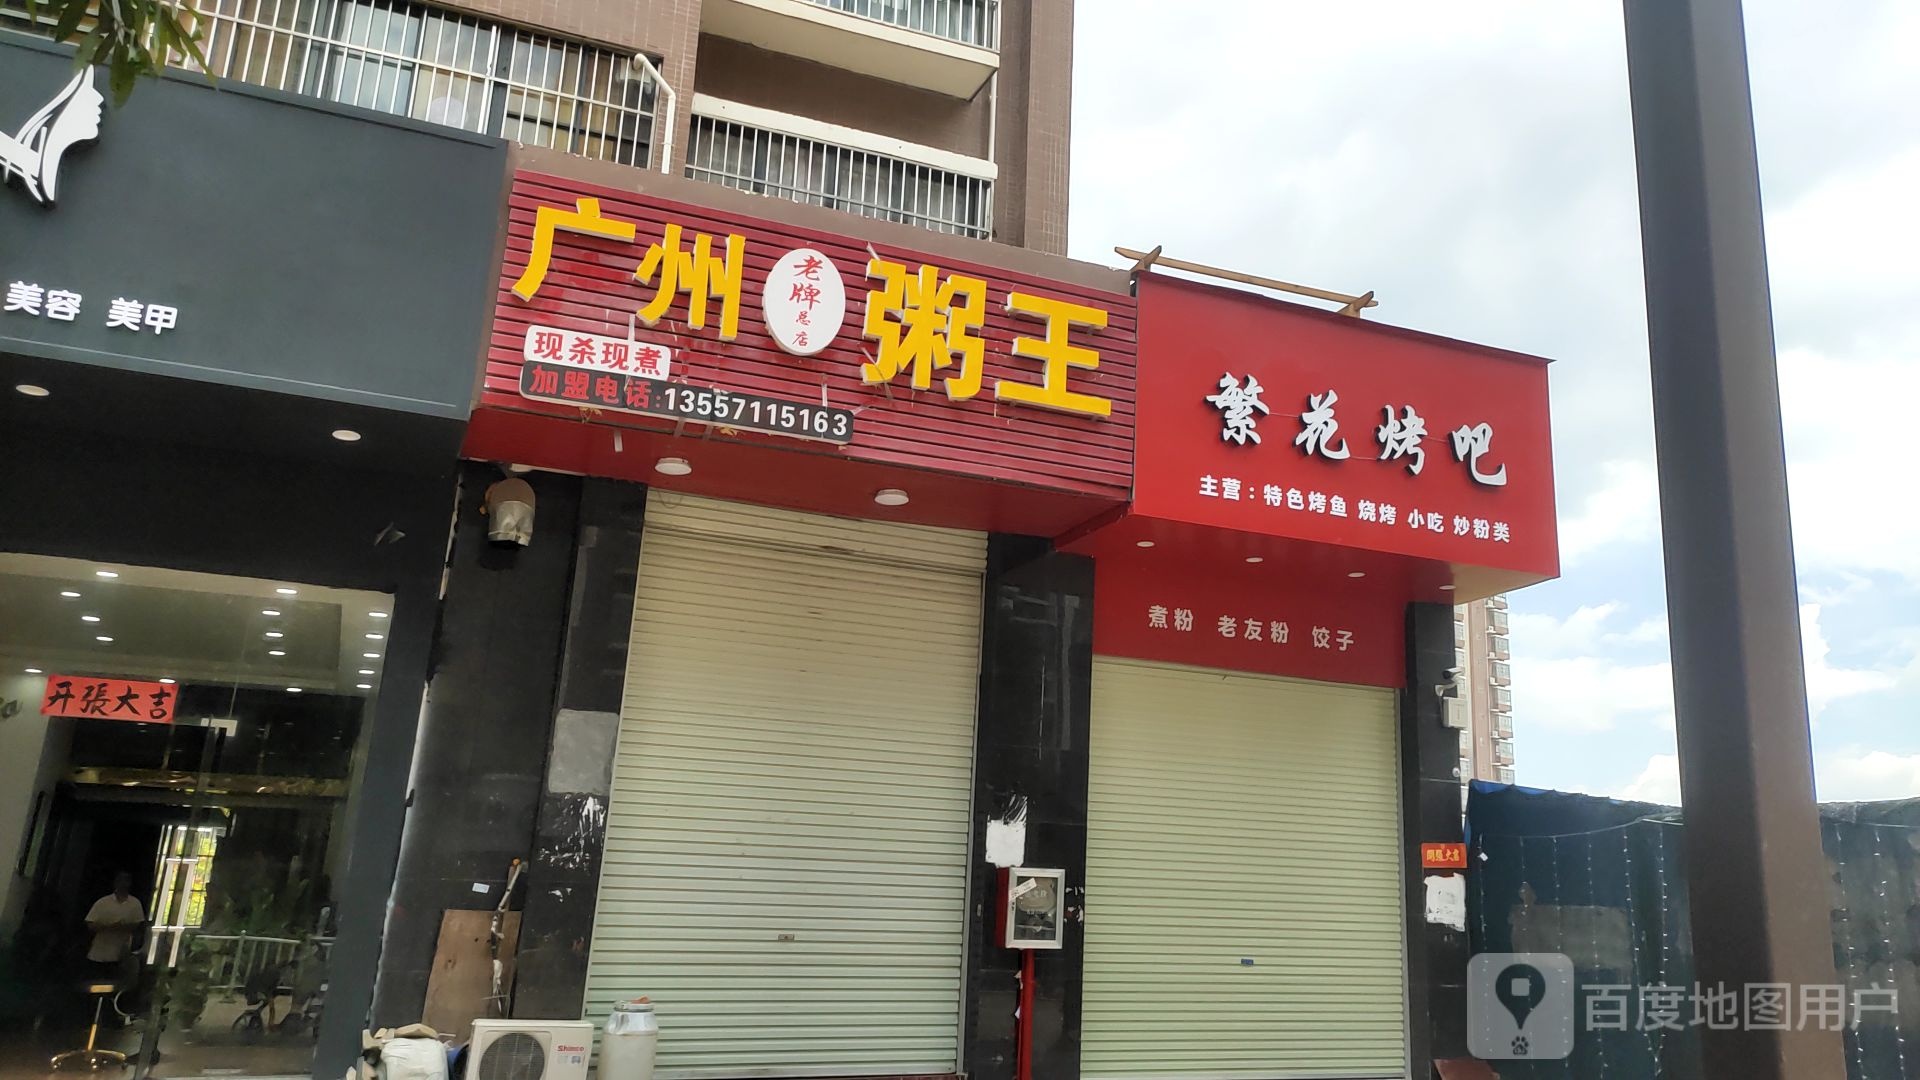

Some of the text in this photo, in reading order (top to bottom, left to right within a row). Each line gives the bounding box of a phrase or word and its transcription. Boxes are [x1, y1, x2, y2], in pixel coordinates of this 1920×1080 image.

[3, 281, 178, 335] 美容 美甲
[511, 198, 1112, 417] 广州 粥王
[533, 331, 663, 376] 现杀现煮
[1205, 371, 1508, 487] 繁花烤吧
[1357, 499, 1397, 526] 烧烤
[1407, 508, 1445, 534] 小吃
[1453, 515, 1511, 543] 炒粉类
[1148, 604, 1355, 652] 煮粉 老友粉 饺子
